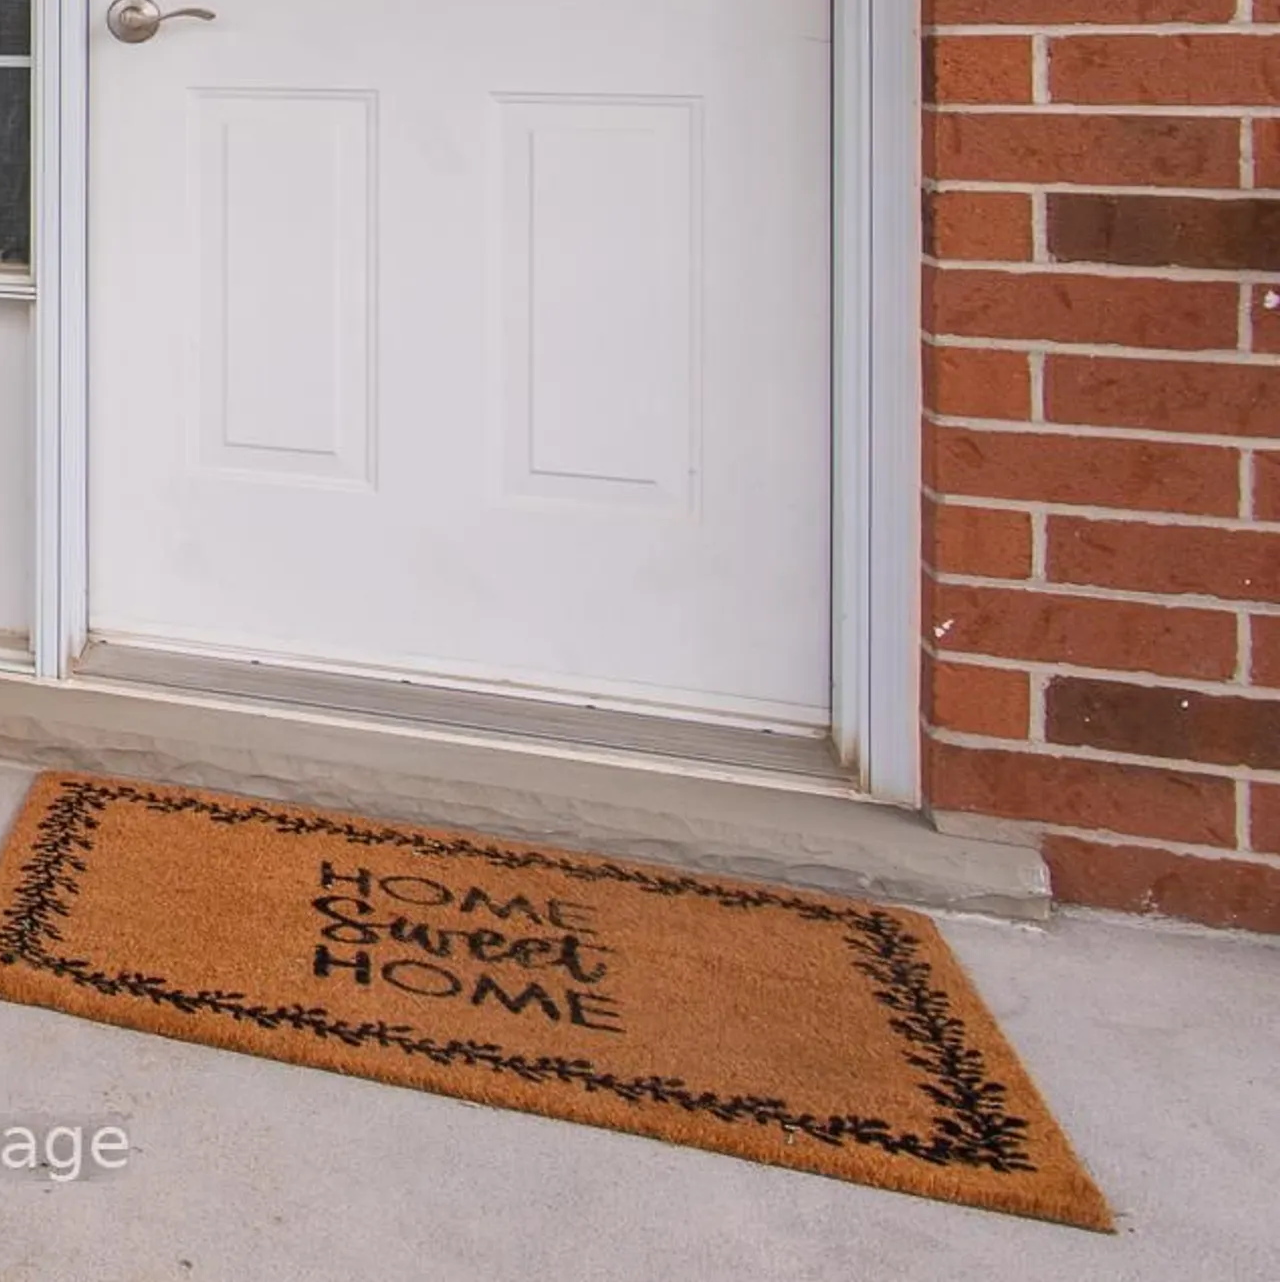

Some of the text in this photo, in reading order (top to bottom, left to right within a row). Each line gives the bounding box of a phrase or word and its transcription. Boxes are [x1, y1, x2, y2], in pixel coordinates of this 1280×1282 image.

[312, 895, 616, 984] Sweet
[320, 861, 599, 937] HOME
[313, 944, 627, 1034] HOME
